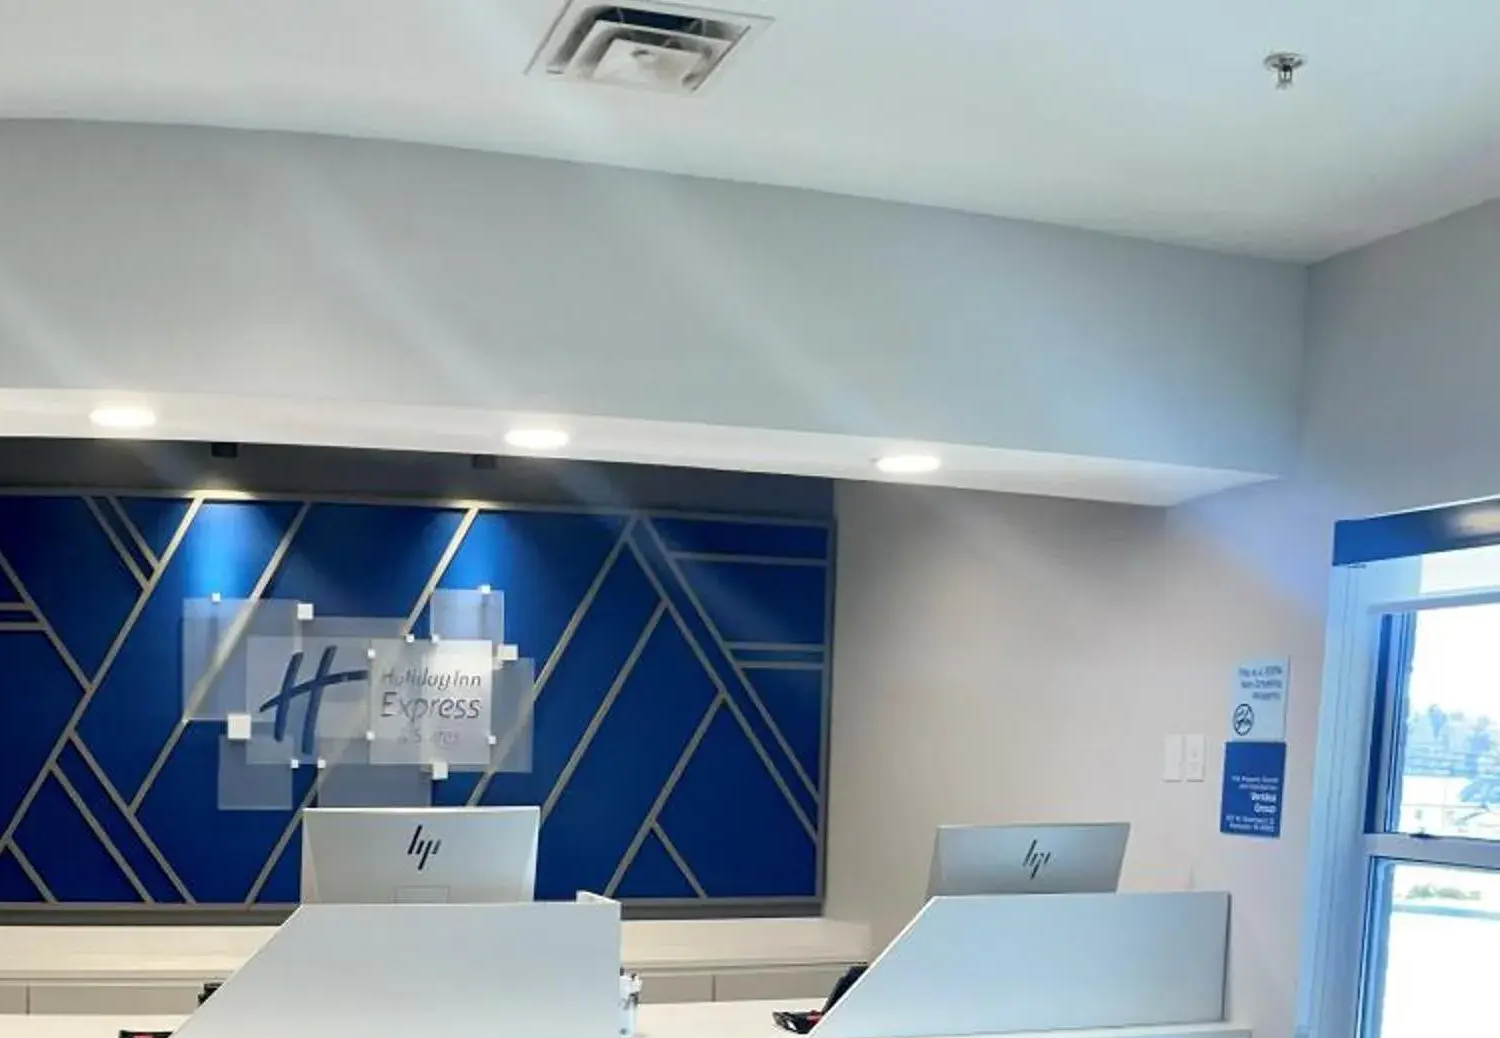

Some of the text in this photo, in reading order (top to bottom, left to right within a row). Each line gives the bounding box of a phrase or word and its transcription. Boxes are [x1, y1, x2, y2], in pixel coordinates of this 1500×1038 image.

[380, 691, 482, 723] Express
[407, 824, 442, 870] hp
[1023, 838, 1051, 880] hp
